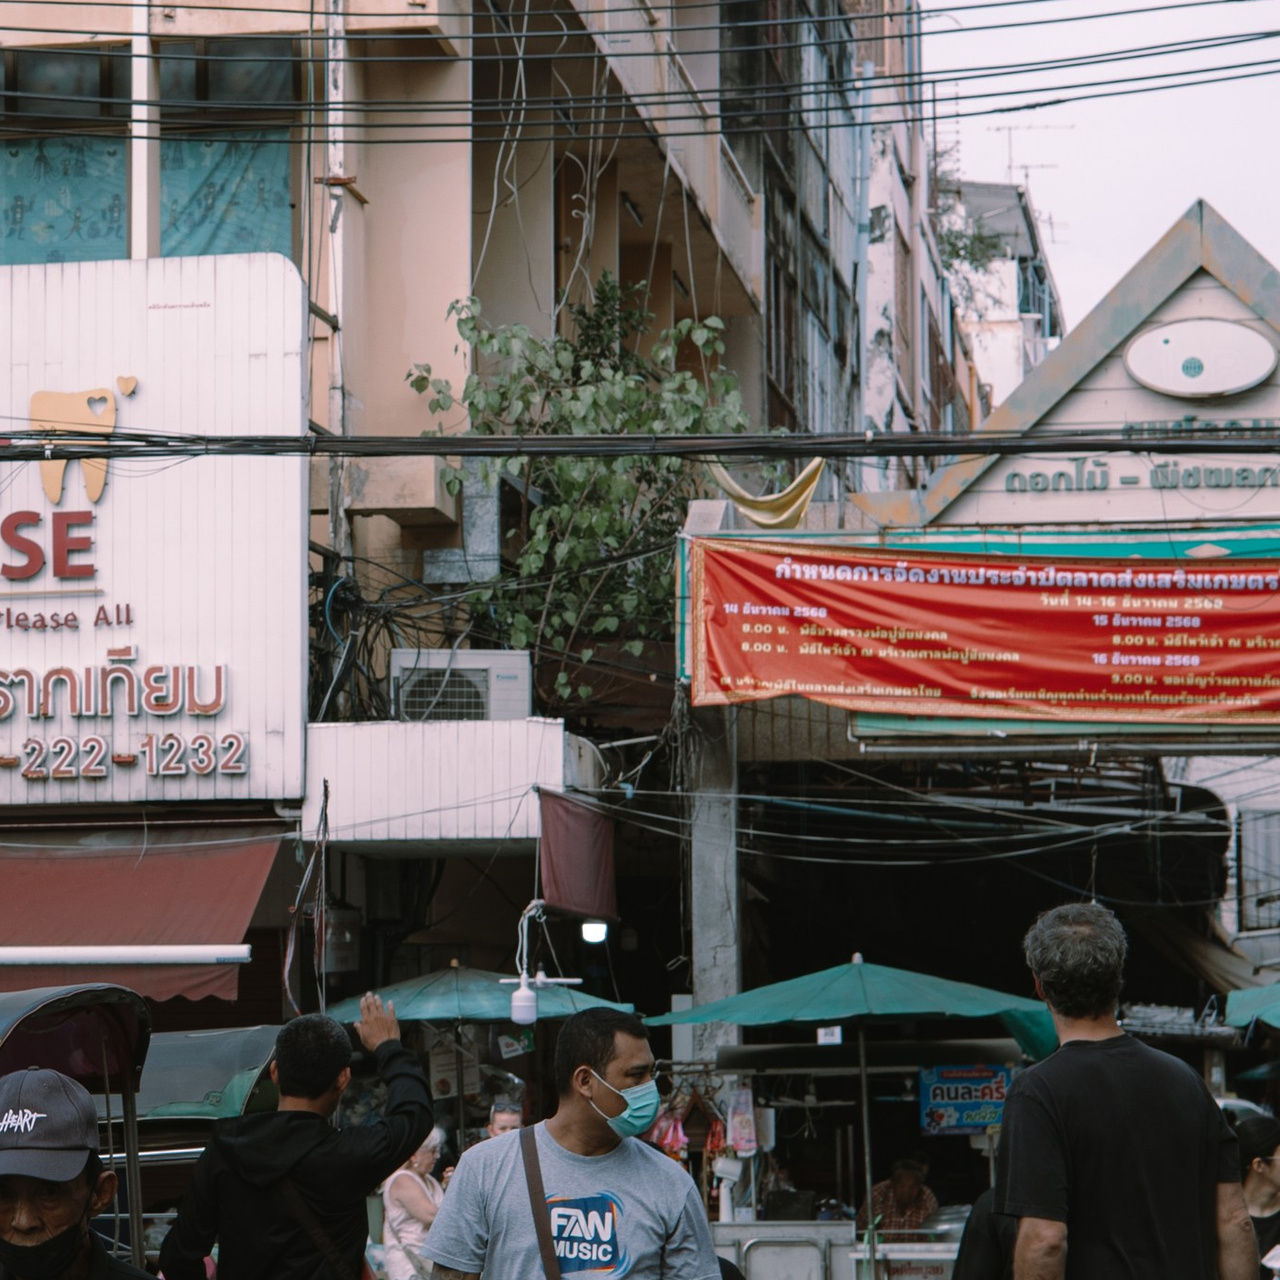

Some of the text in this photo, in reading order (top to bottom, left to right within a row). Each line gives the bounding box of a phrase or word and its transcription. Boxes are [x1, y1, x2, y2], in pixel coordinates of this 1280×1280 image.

[1005, 457, 1110, 492] ดอกไม้
[1040, 589, 1069, 607] วันที่
[94, 603, 134, 627] All
[550, 1206, 613, 1242] FAN
[553, 1239, 613, 1262] MUSIC
